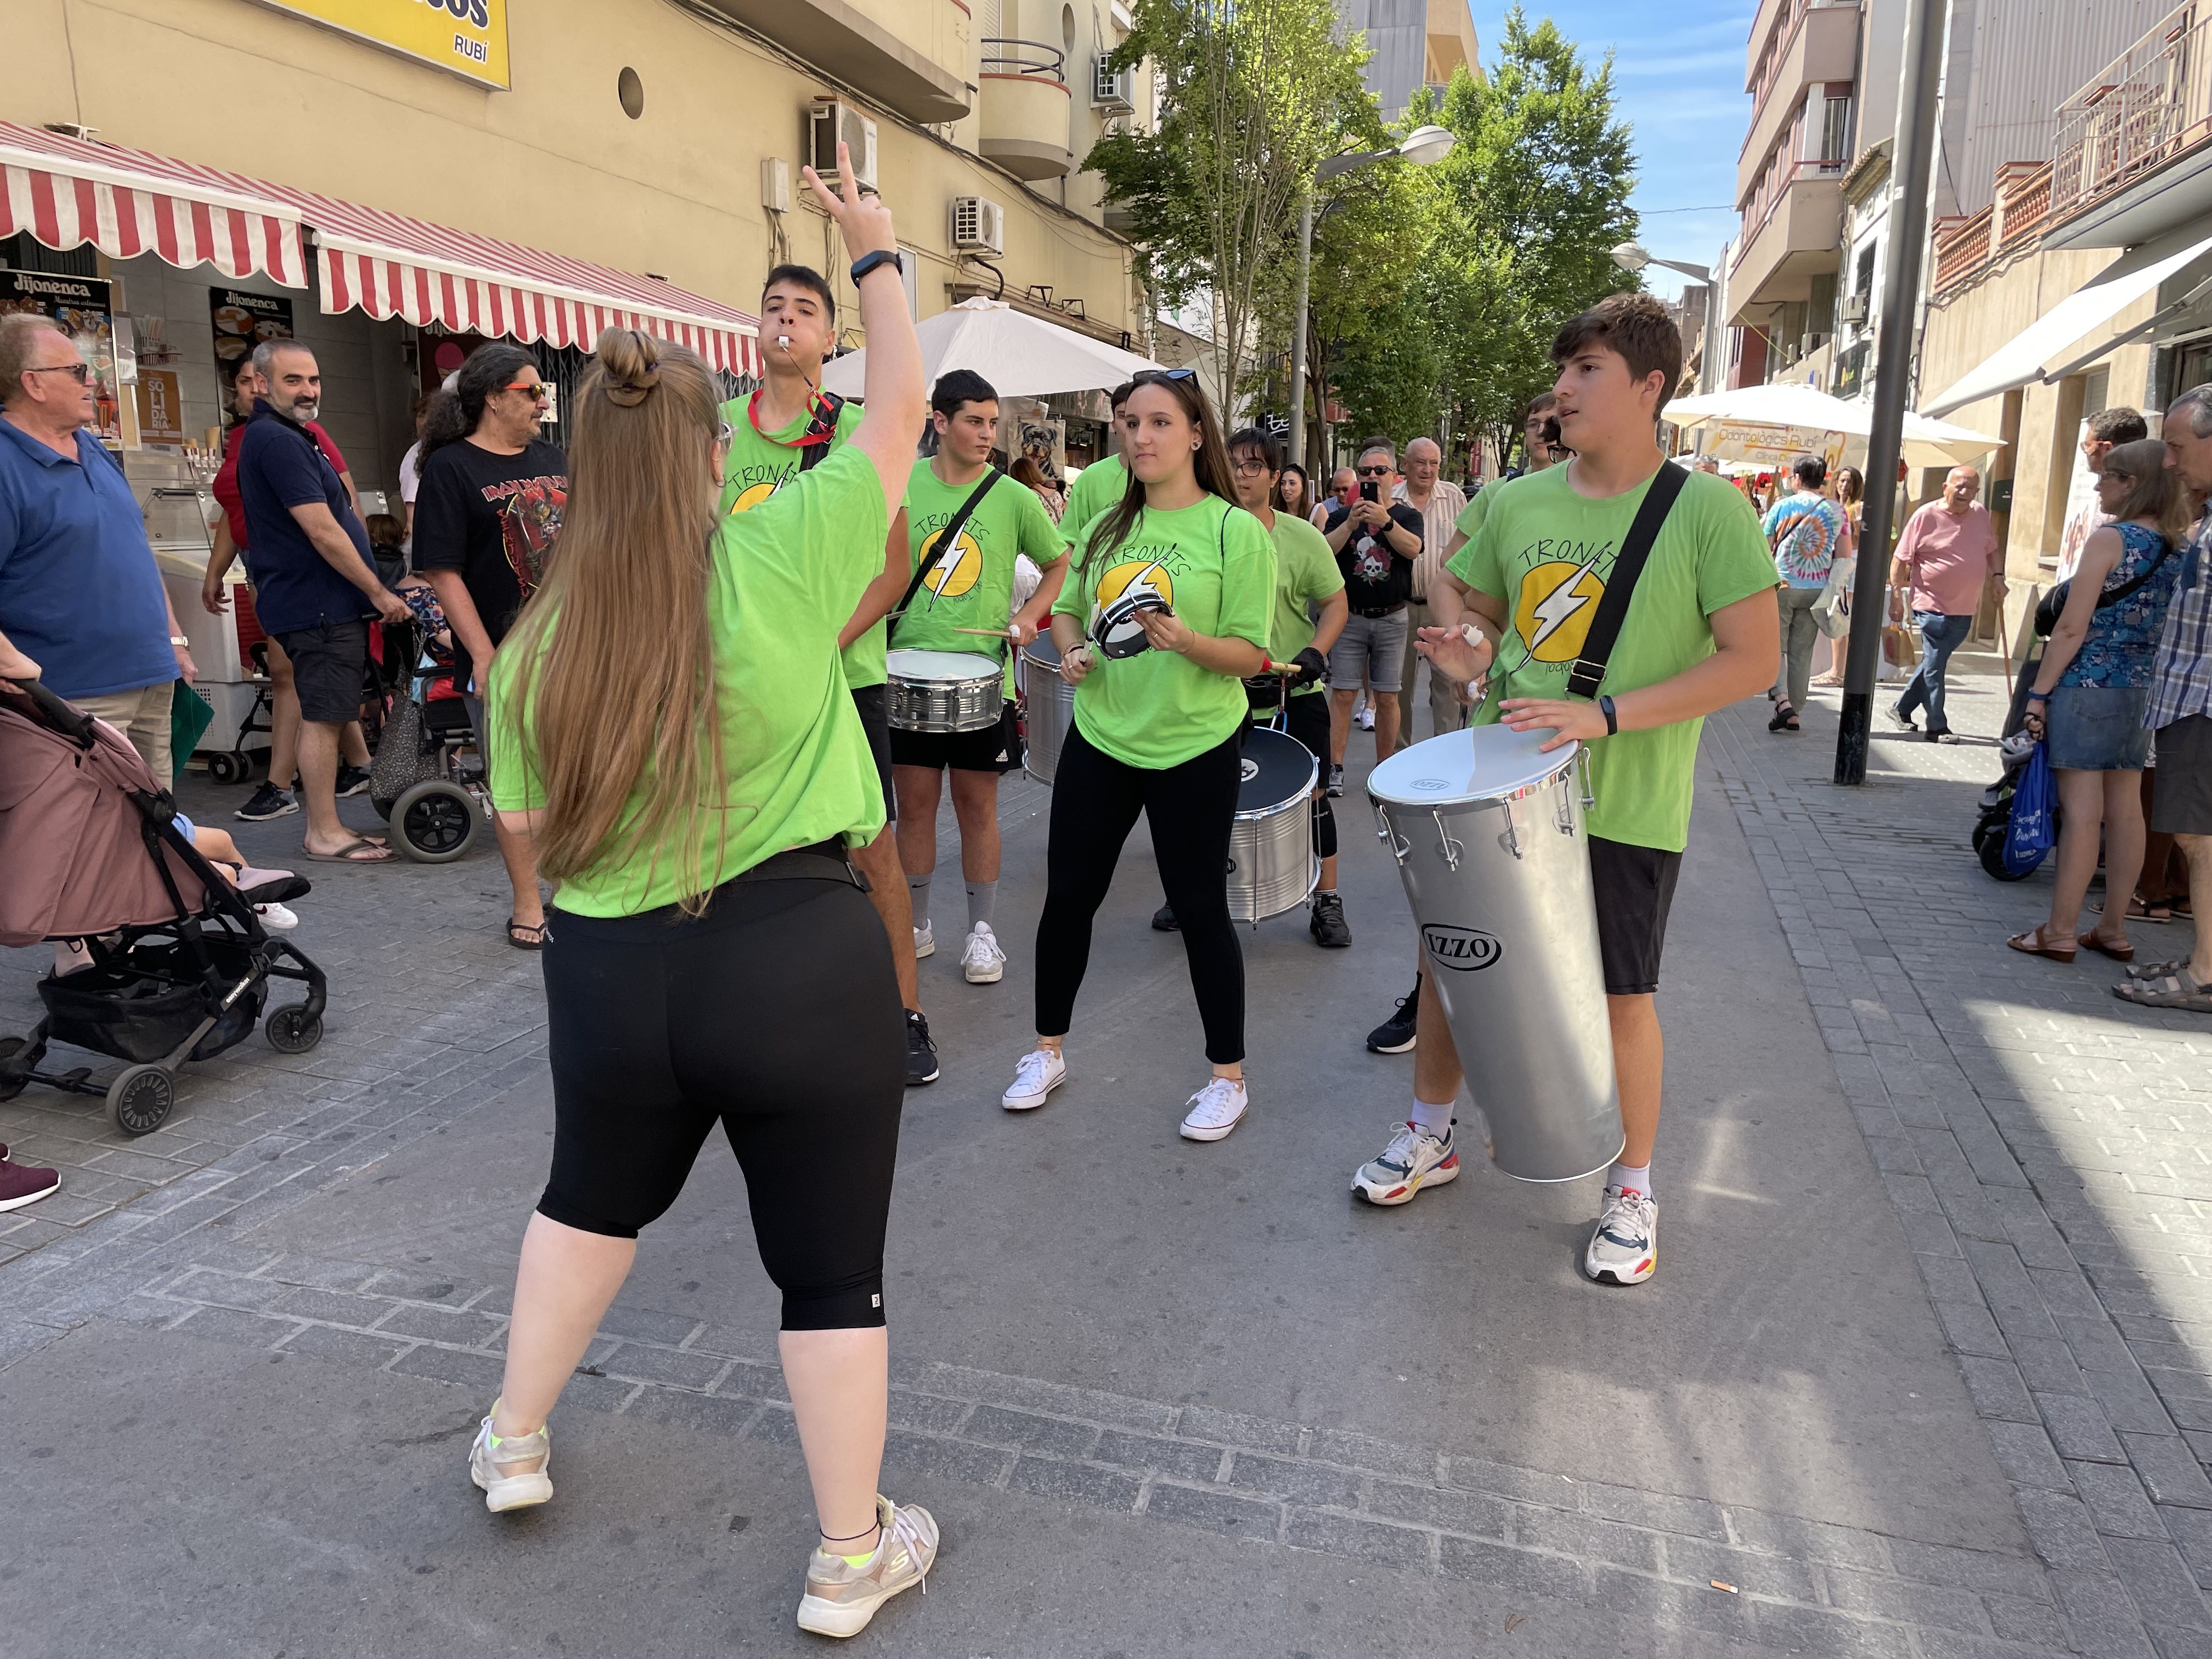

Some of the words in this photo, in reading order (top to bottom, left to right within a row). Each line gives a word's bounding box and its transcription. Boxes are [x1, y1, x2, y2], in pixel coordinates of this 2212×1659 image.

[454, 35, 487, 63] RUBÍ
[1718, 428, 1788, 447] Odontològics
[1790, 434, 1817, 448] Rubí
[1426, 932, 1490, 958] IZZO
